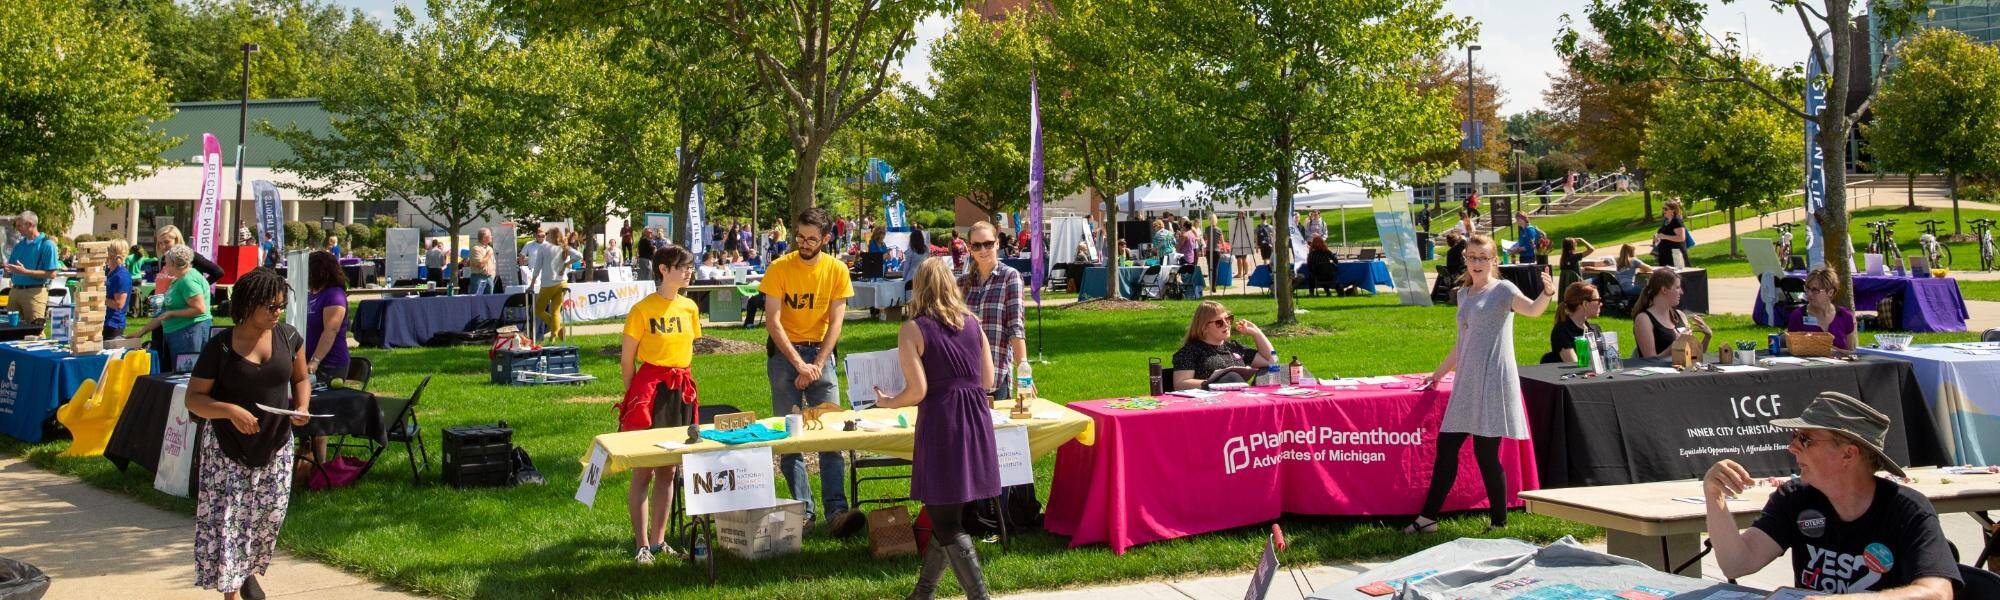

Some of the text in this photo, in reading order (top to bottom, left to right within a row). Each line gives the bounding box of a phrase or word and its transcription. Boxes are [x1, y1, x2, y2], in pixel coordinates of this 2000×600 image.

[1810, 79, 1827, 208] STUNT LIF
[587, 284, 640, 305] DSAWM
[783, 292, 815, 310] NSI
[1730, 394, 1782, 419] ICCF
[1249, 426, 1316, 451] Planned
[1687, 426, 1715, 438] INNER
[1716, 426, 1734, 437] CITY
[1736, 424, 1784, 436] CHRISTIAN
[1252, 449, 1386, 469] Advocates of Michigan
[1707, 446, 1740, 456] Opportunity
[692, 469, 736, 495] NSI
[1806, 544, 1855, 579] YES
